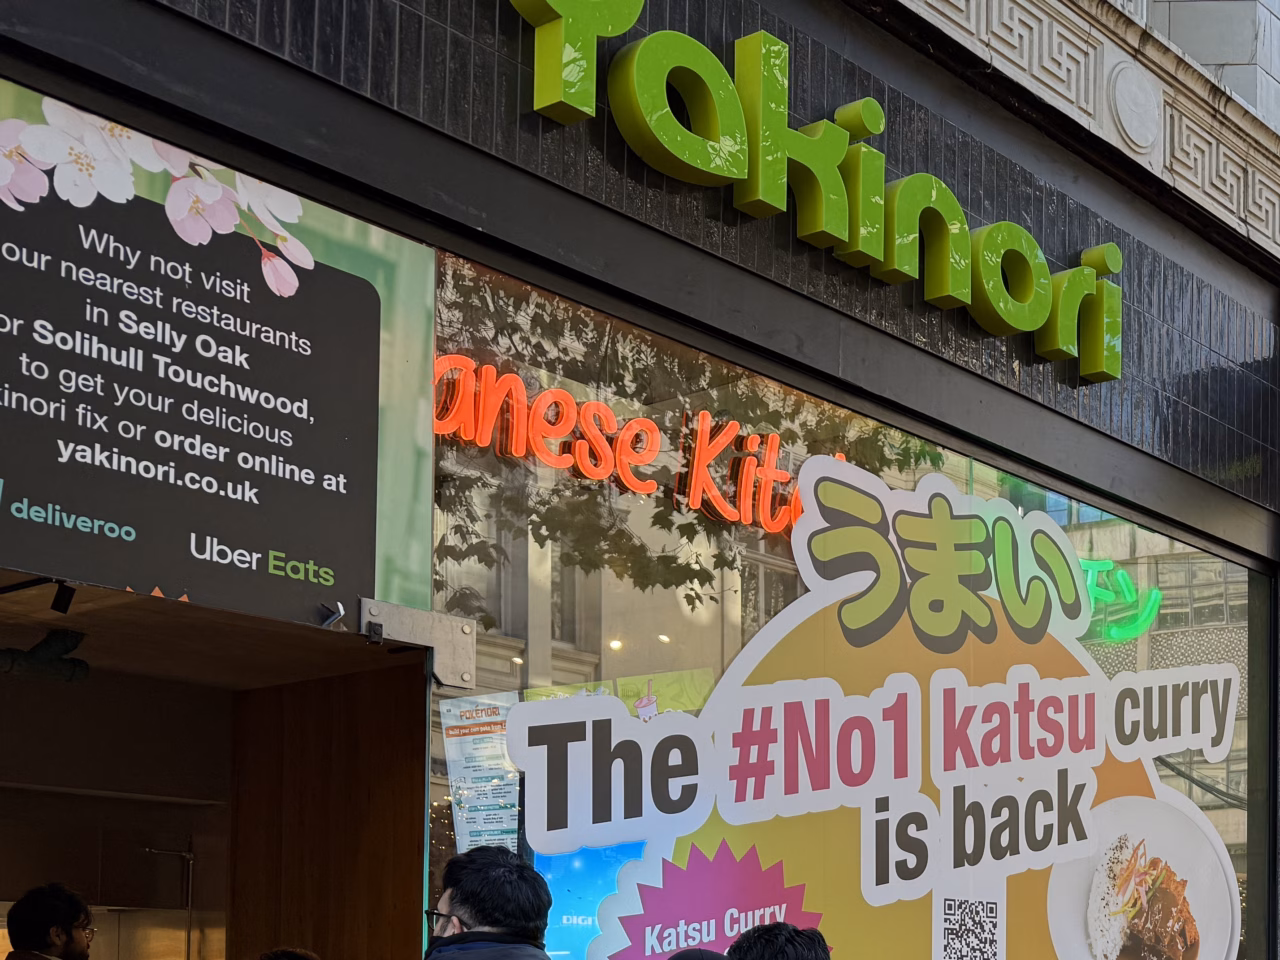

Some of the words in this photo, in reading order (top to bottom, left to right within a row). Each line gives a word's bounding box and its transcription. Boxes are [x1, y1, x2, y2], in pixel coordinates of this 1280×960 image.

[511, 0, 1122, 386] Yakinori
[1, 242, 51, 271] our
[61, 258, 163, 309] nearest
[172, 296, 312, 355] restaurants
[78, 224, 141, 269] Why
[151, 252, 192, 284] not
[200, 271, 251, 304] visit
[32, 319, 143, 371] Solihull
[152, 353, 315, 424] Touchwood,
[85, 298, 109, 326] in
[118, 309, 188, 353] Selly
[195, 334, 250, 370] Oak
[0, 383, 66, 422] inori
[75, 404, 109, 433] fix
[118, 420, 147, 441] or
[154, 429, 230, 463] order
[237, 450, 315, 485] online
[322, 472, 347, 494] at
[19, 352, 49, 380] to
[58, 367, 104, 396] get
[113, 381, 174, 415] your
[182, 400, 293, 447] delicious
[10, 497, 136, 542] deliveroo
[57, 439, 260, 505] yakinori.co.uk
[190, 532, 262, 571] Uber
[268, 550, 335, 587] Eats
[808, 476, 1082, 655] うまい
[527, 718, 699, 832] The
[728, 691, 909, 804] #No1
[942, 681, 1097, 772] katsu
[1114, 676, 1233, 764] curry
[874, 795, 929, 886] is
[952, 768, 1088, 871] back
[562, 915, 592, 926] DIGI
[645, 918, 716, 957] Katsu
[724, 903, 787, 938] Curry
